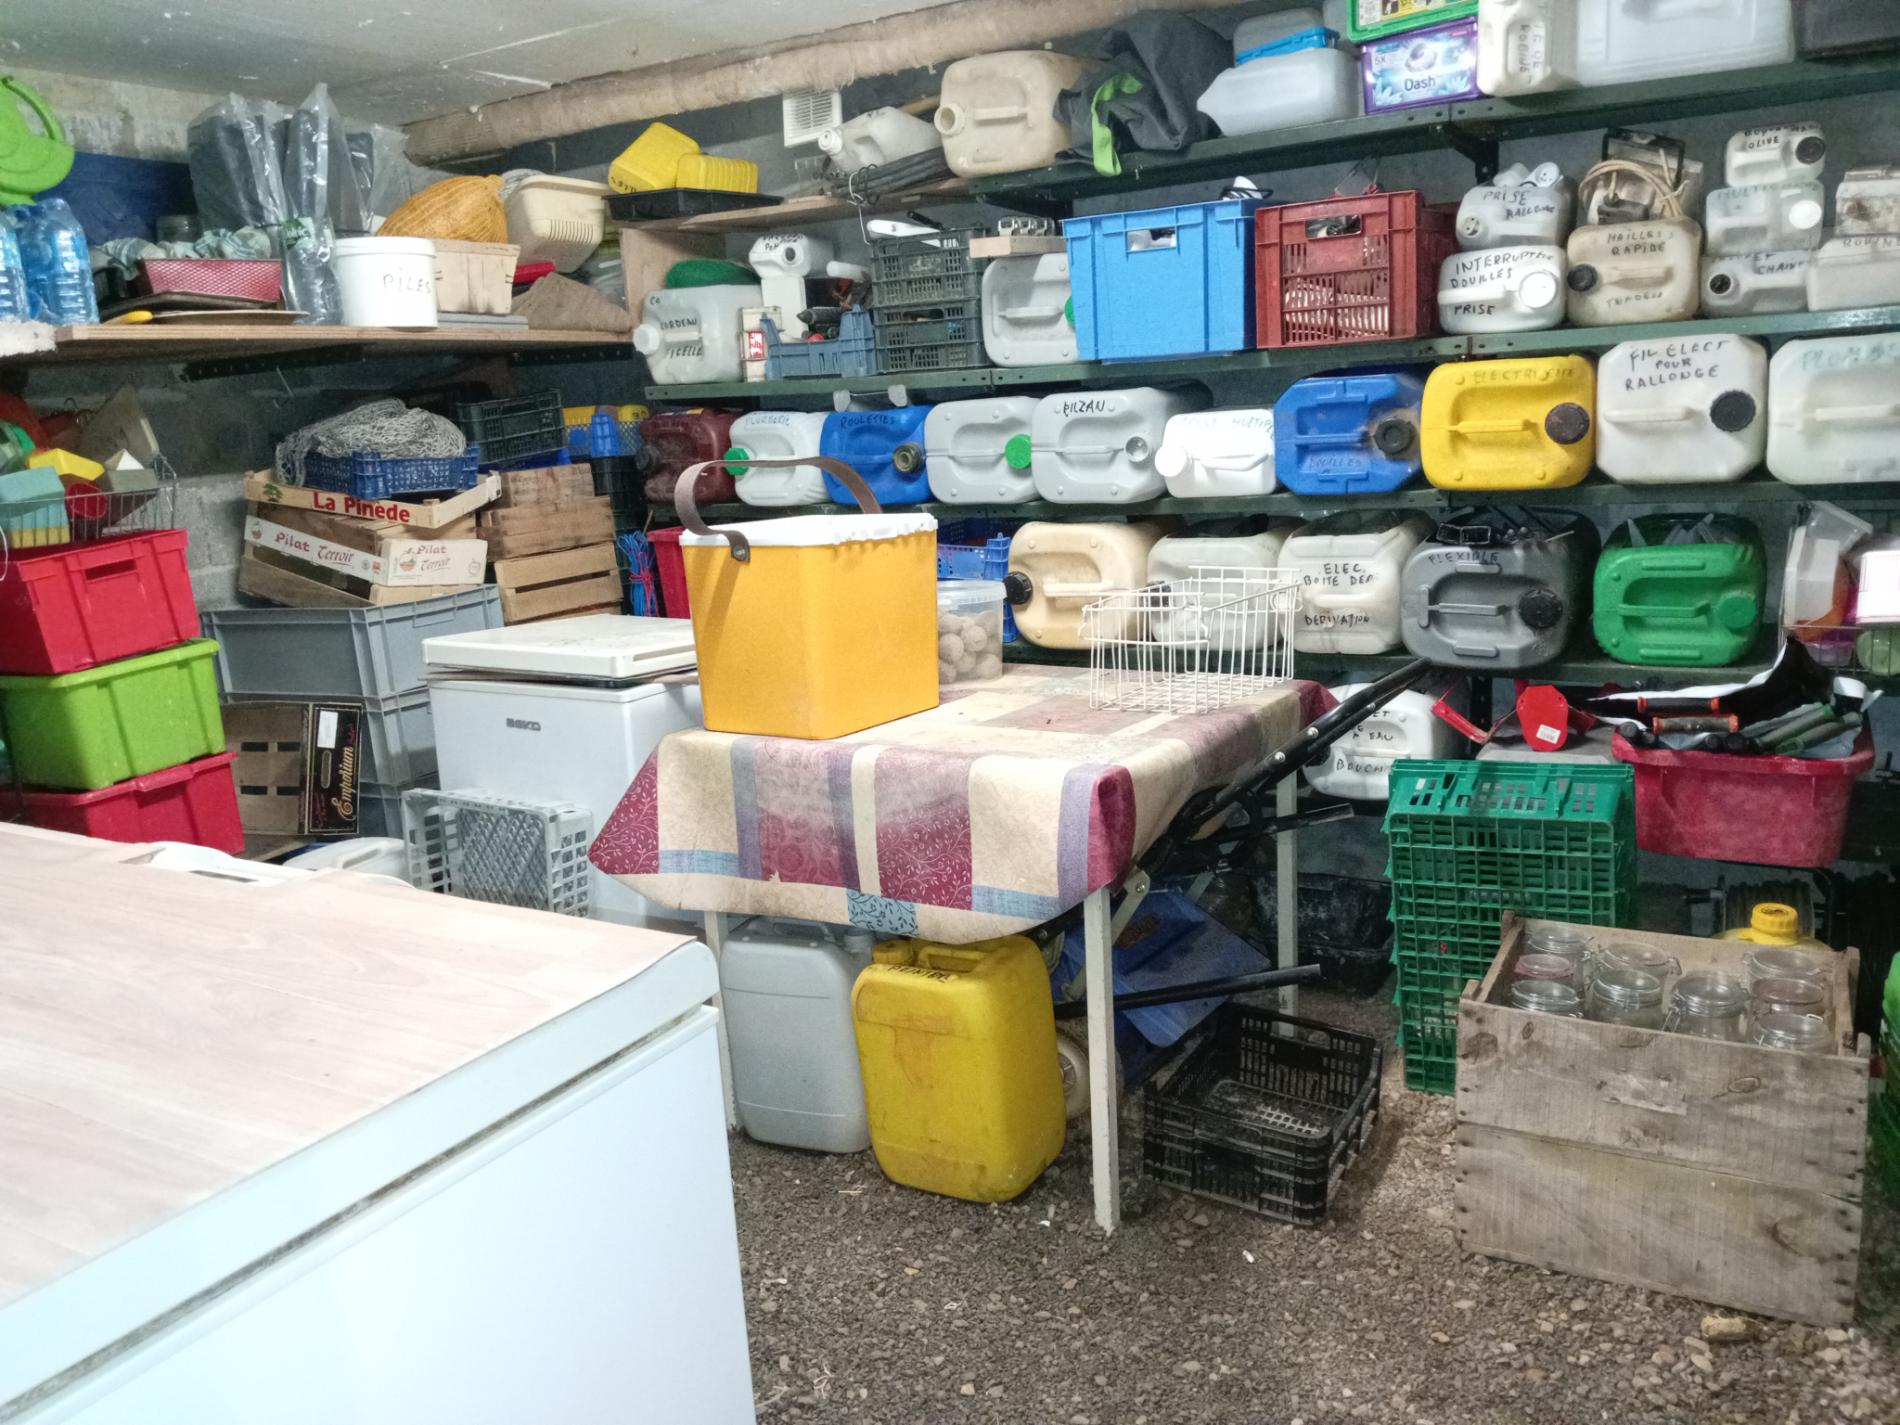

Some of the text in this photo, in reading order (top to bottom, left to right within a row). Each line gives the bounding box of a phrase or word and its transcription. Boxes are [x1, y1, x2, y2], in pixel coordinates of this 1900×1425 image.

[1404, 76, 1436, 91] Dash
[1748, 136, 1780, 149] OLIVE
[1483, 190, 1530, 205] PRISE
[1611, 241, 1666, 256] RAPIDE
[383, 266, 431, 294] PILES
[1450, 268, 1512, 288] DOUILLES
[1454, 304, 1495, 315] PRISE
[1630, 340, 1731, 372] FIL ELECT
[1655, 358, 1692, 370] POUR
[1625, 364, 1719, 391] RALLONGE
[313, 491, 335, 511] La
[274, 532, 310, 552] Pilat
[417, 544, 447, 555] Pilat
[1303, 575, 1340, 587] BOITE
[331, 746, 357, 821] Emporium
